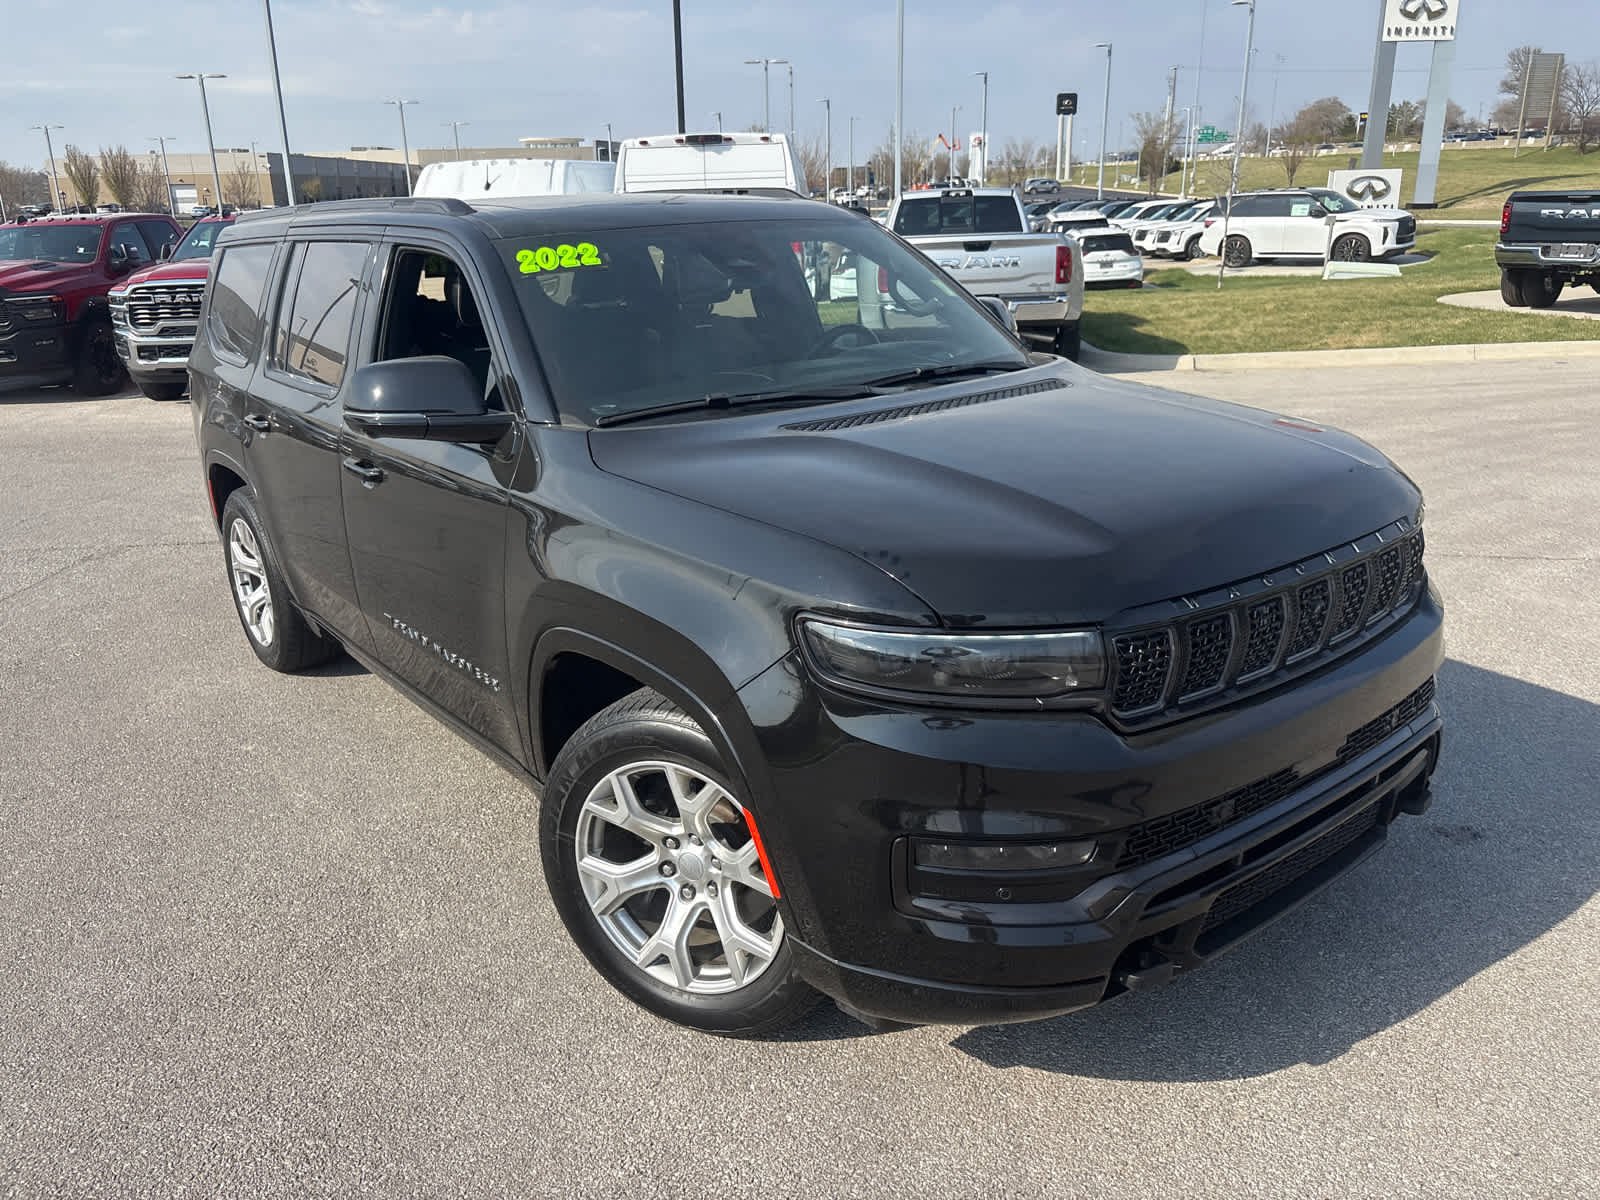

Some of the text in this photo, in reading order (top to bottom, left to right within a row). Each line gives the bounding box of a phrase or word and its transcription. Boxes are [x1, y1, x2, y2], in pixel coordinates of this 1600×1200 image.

[1387, 25, 1455, 37] INFINITI
[516, 242, 601, 273] 2022
[936, 255, 1021, 270] RAM
